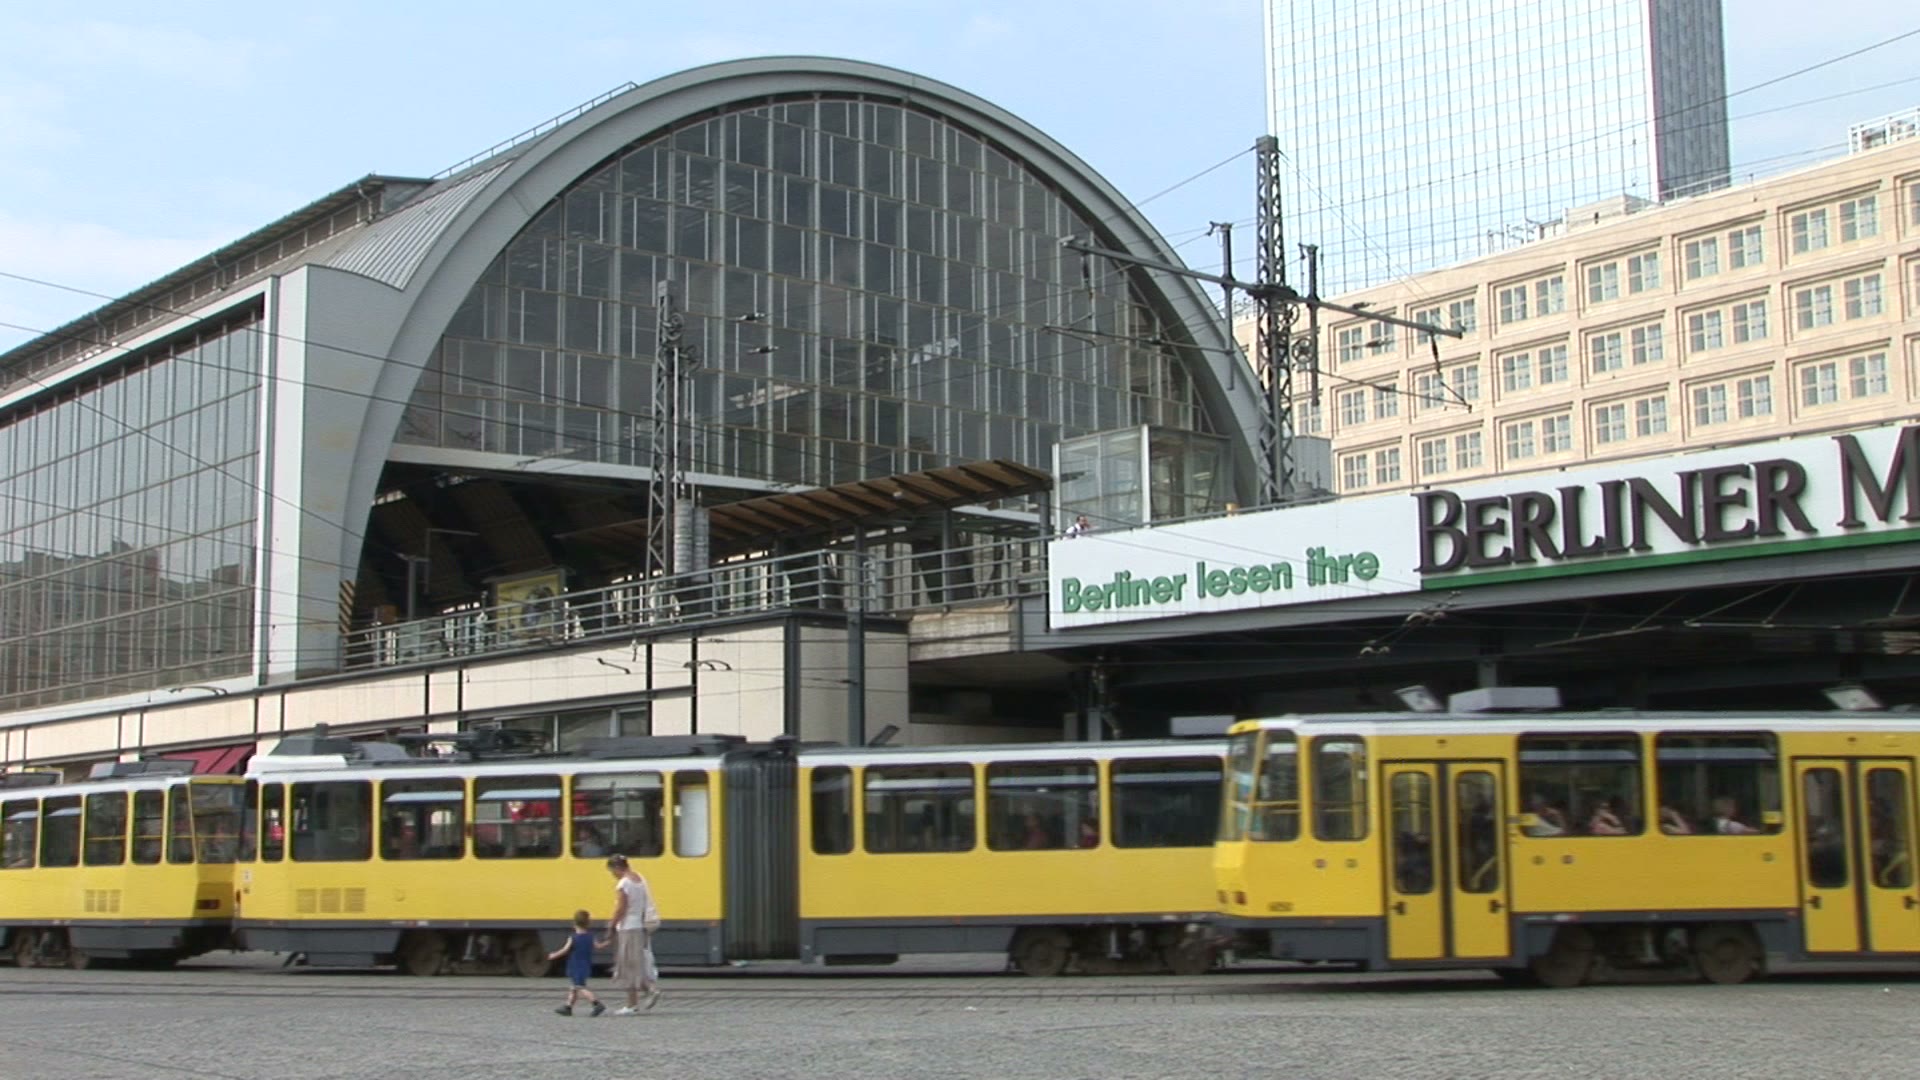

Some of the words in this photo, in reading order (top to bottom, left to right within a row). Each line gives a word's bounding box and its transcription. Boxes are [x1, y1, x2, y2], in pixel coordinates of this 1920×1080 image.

[1411, 458, 1818, 574] BERLINER
[1062, 570, 1187, 613] Berliner
[1196, 561, 1293, 598] lesen
[1306, 547, 1380, 587] ihre
